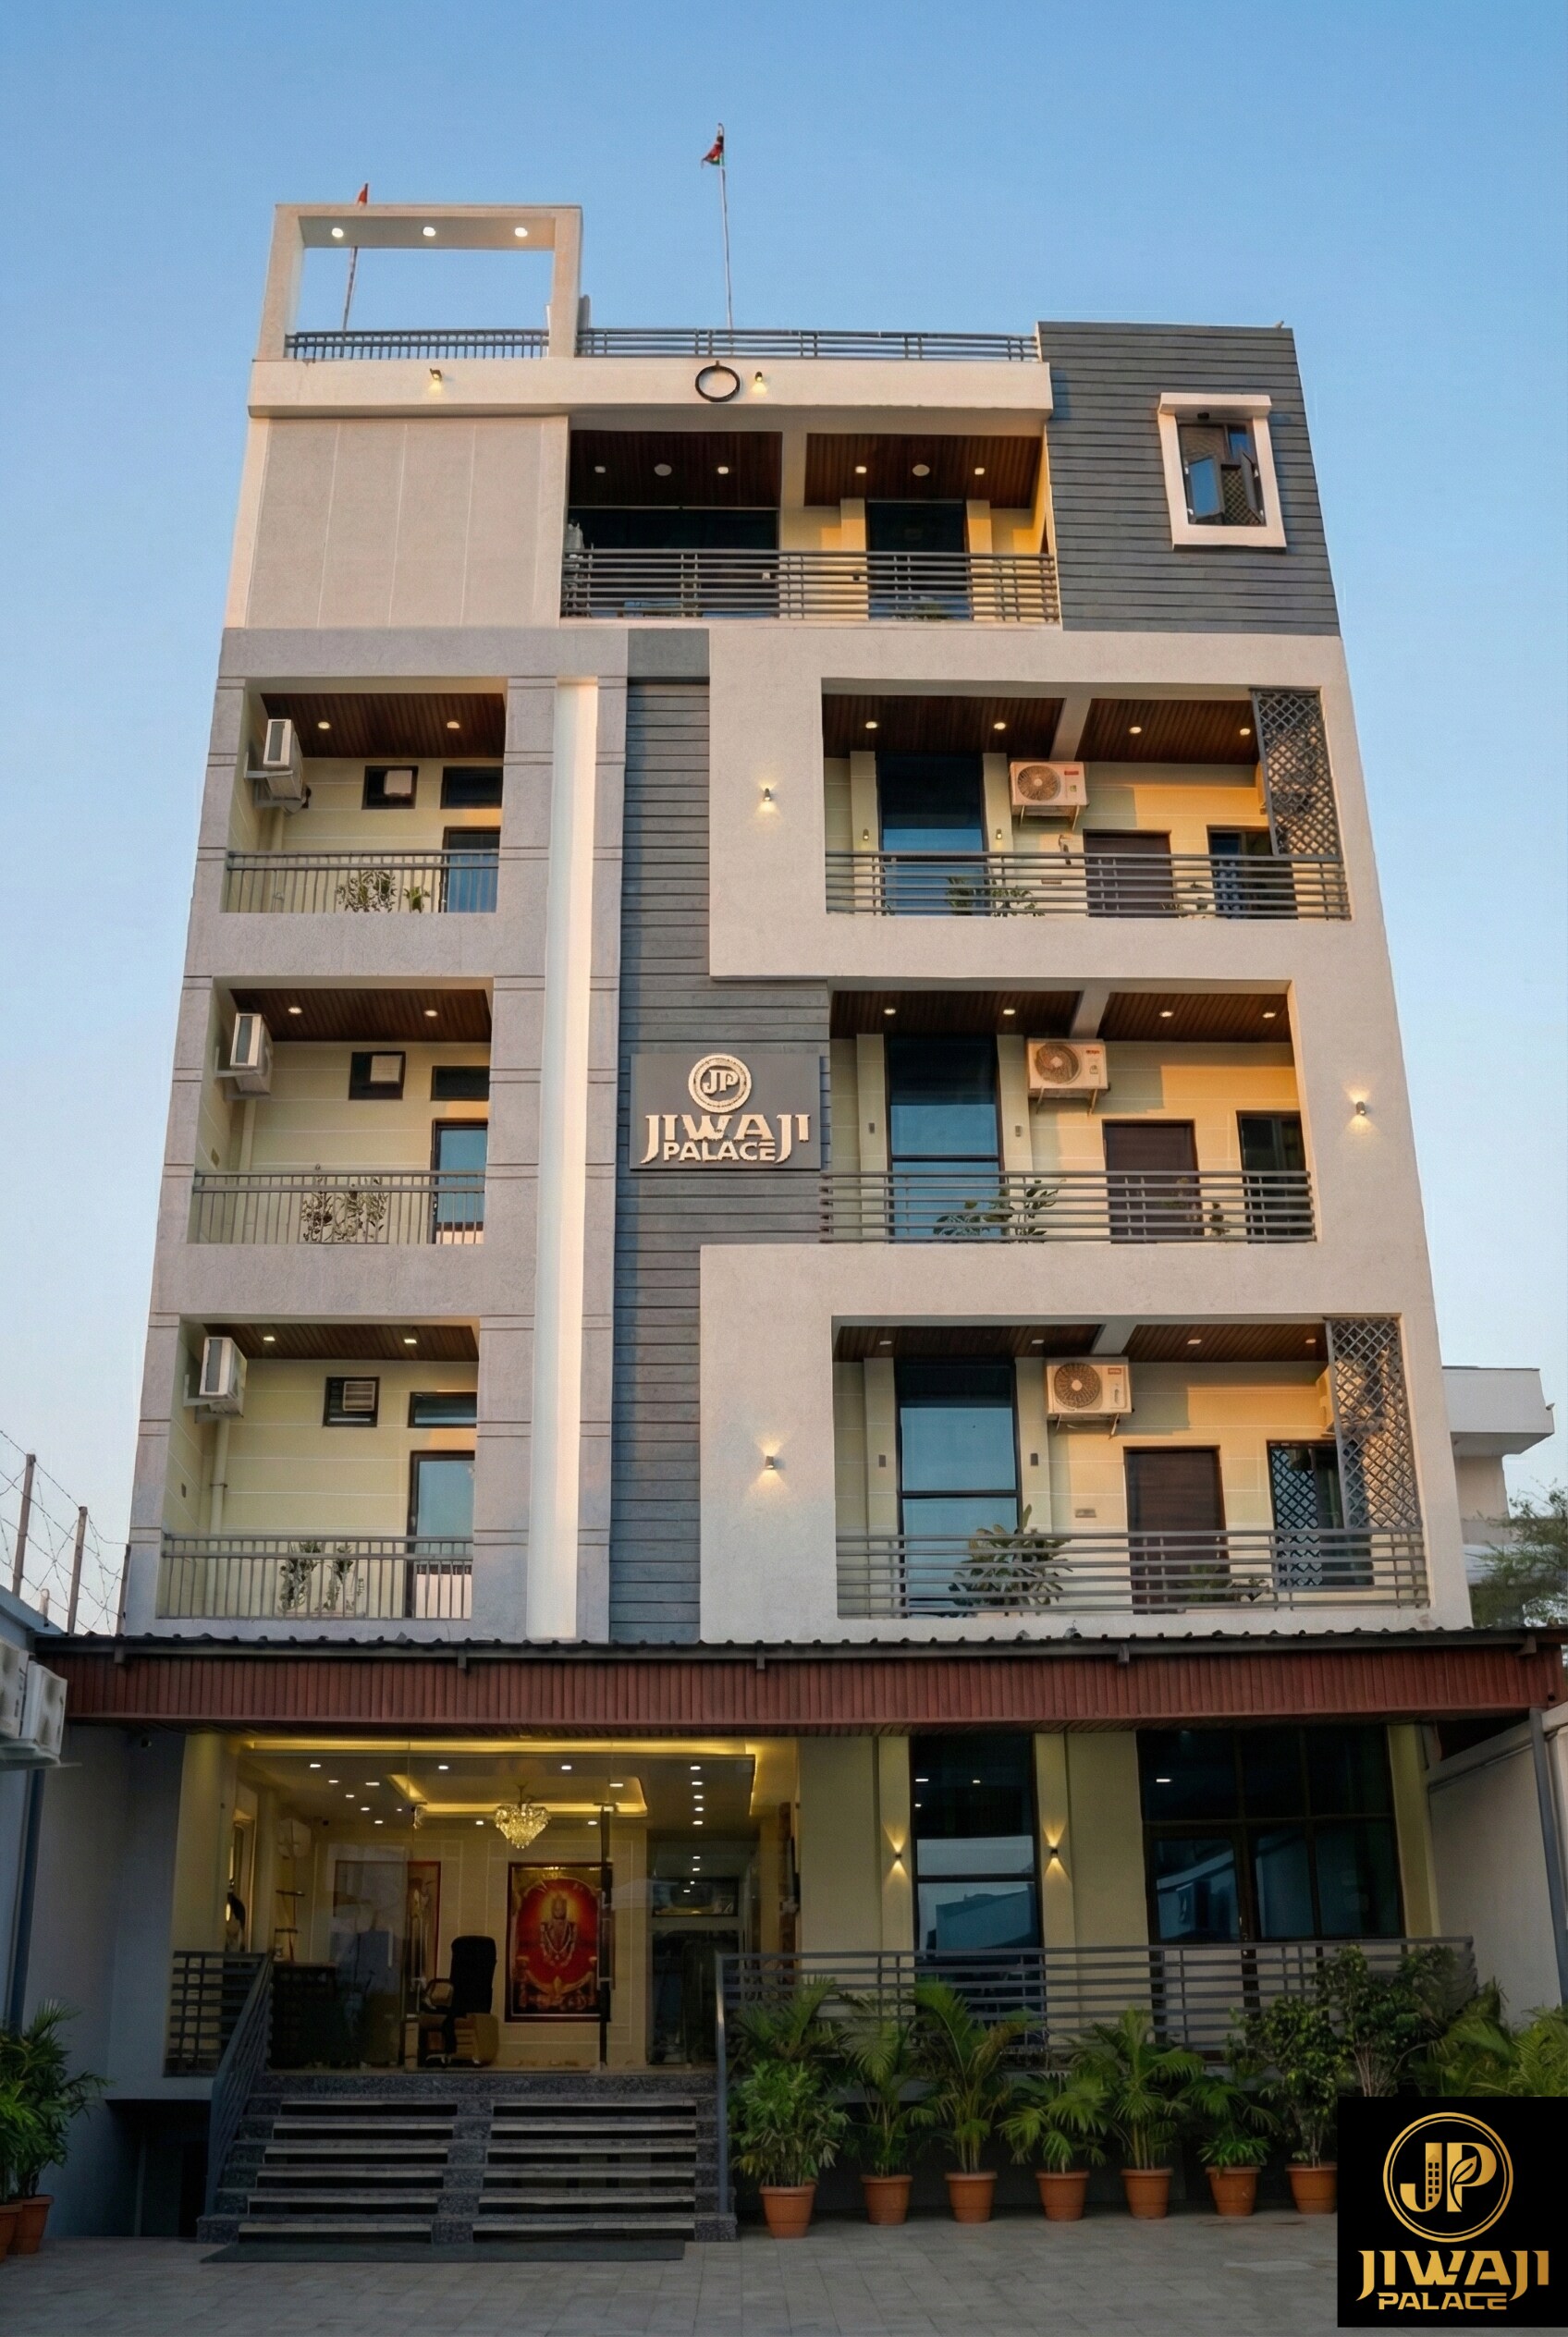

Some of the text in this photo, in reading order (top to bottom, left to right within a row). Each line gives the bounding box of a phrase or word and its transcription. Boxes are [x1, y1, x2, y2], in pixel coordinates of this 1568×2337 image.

[703, 1069, 739, 1094] JP
[641, 1114, 810, 1164] JIWAJI
[664, 1141, 776, 1162] PALACE
